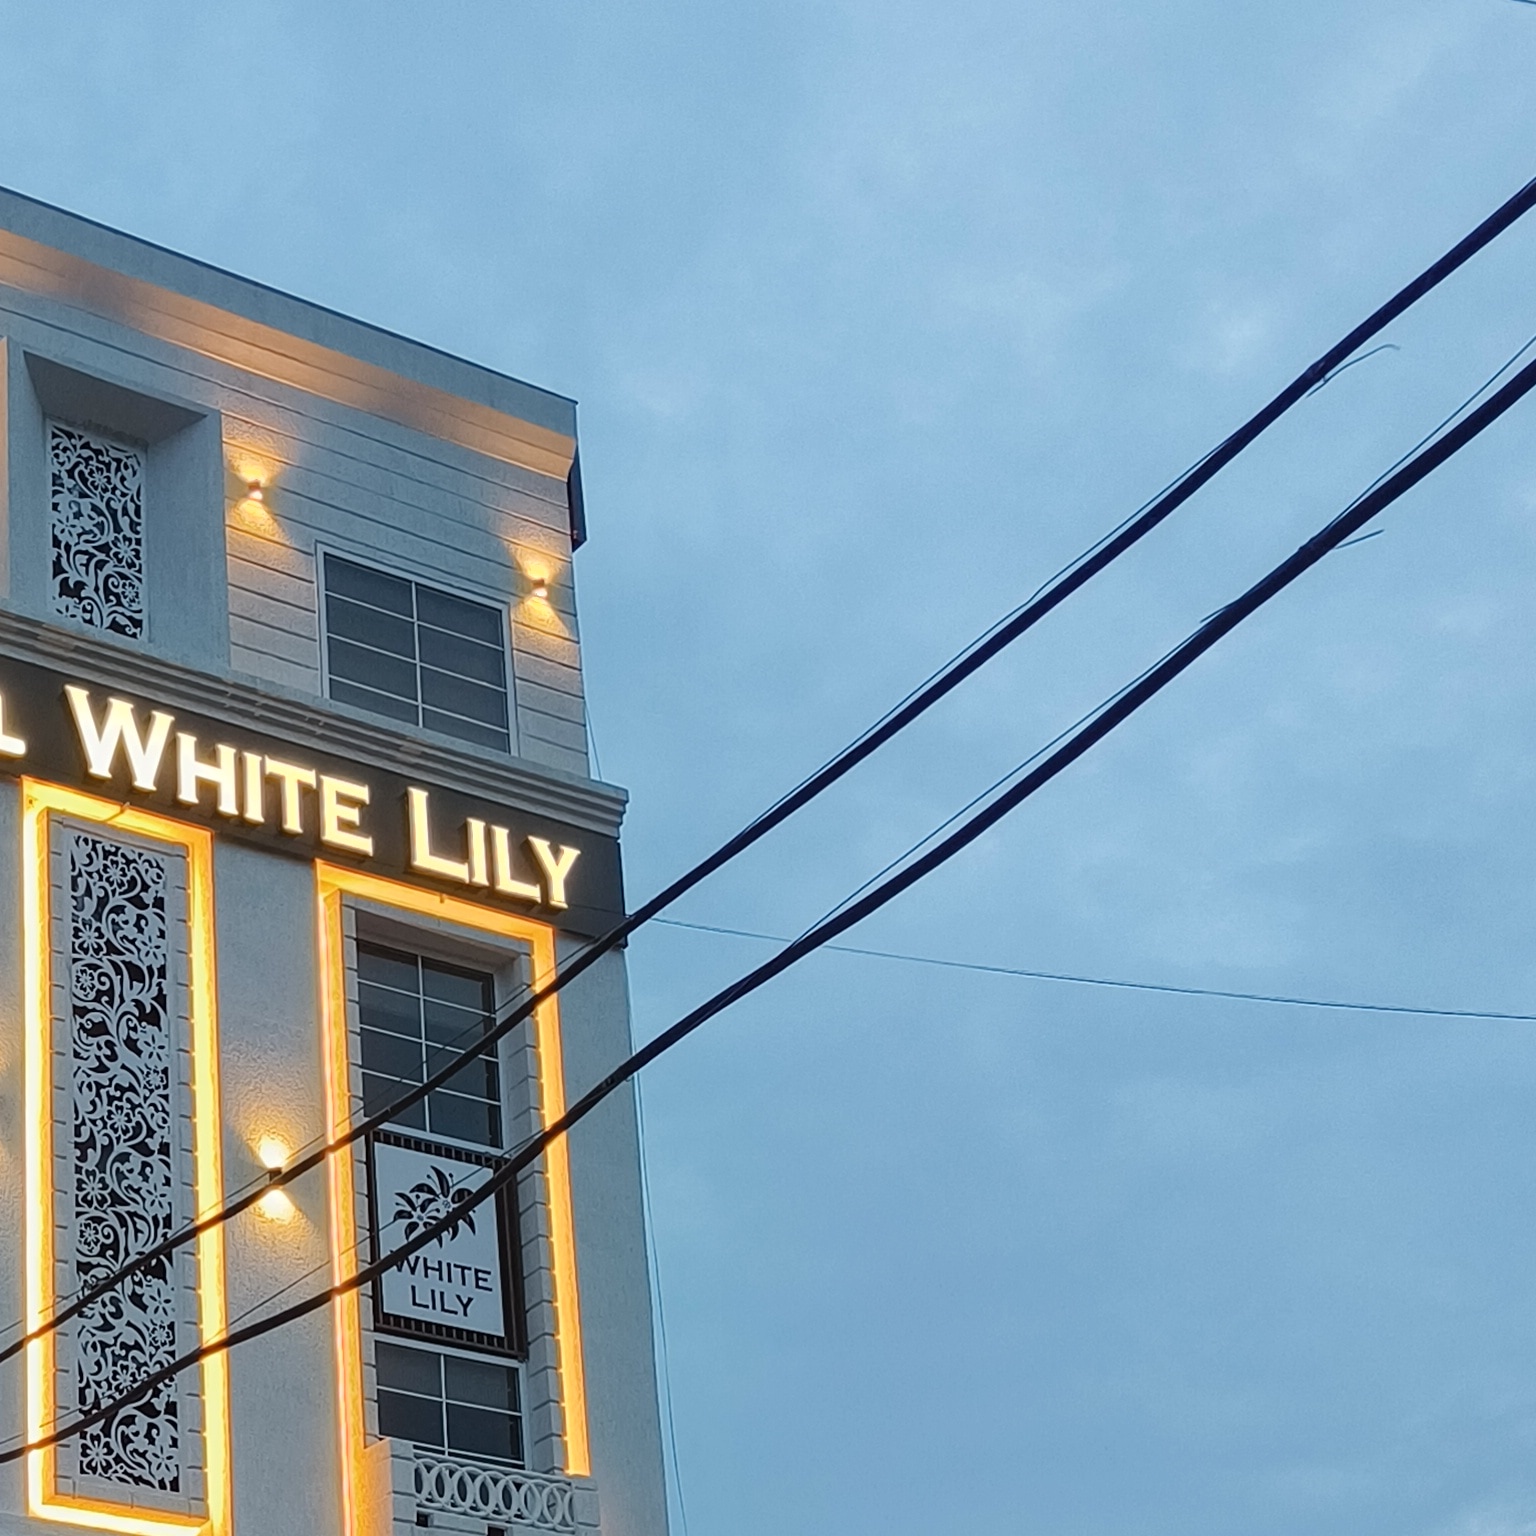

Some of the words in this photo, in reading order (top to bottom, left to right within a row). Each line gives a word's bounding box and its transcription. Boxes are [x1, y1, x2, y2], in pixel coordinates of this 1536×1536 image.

[64, 684, 375, 858] WHITE
[406, 786, 582, 911] LILY
[390, 1249, 493, 1292] WHITE
[411, 1285, 474, 1317] LILY
